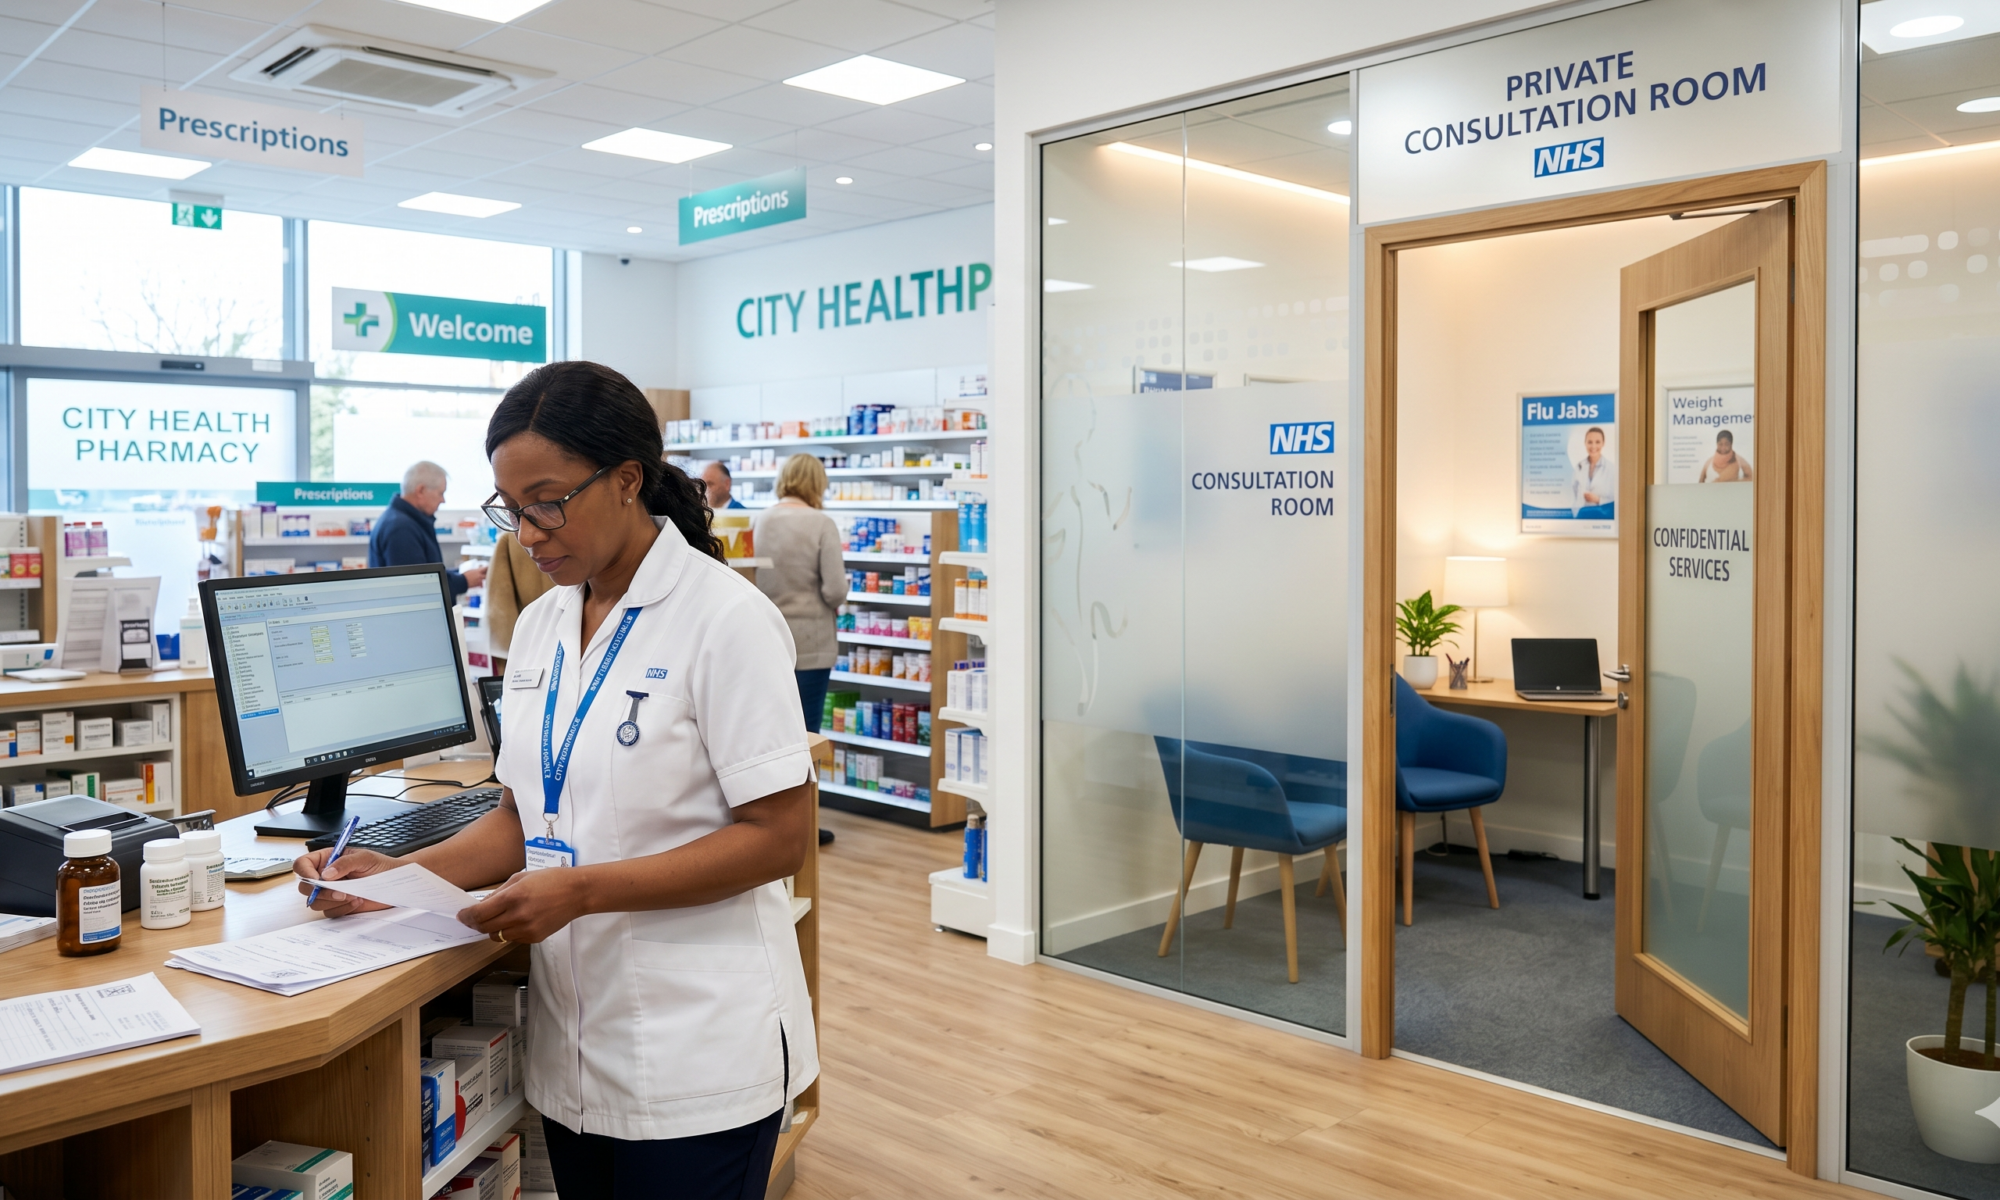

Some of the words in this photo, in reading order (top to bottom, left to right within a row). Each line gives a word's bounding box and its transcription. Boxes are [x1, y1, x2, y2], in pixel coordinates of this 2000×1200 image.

[1507, 51, 1634, 101] PRIVATE
[1404, 88, 1636, 154] CONSULTATION
[1650, 63, 1767, 111] ROOM
[159, 107, 349, 157] Prescriptions
[1536, 139, 1602, 177] NHS
[693, 189, 788, 228] Prescriptions
[736, 290, 806, 339] CITY
[409, 312, 533, 345] Welcome
[1527, 402, 1554, 421] Flu
[1557, 400, 1599, 420] Jabs
[1672, 396, 1723, 412] Weight
[62, 407, 136, 430] CITY
[150, 410, 270, 433] HEALTH
[1672, 413, 1754, 428] Manageme
[1271, 423, 1332, 453] NHS
[77, 439, 260, 464] PHARMACY
[1191, 470, 1334, 491] CONSULTATION
[293, 487, 374, 503] Prescriptions
[1271, 497, 1334, 517] ROOM
[1653, 527, 1750, 552] CONFIDENTIAL
[1669, 556, 1730, 582] SERVICES
[645, 668, 668, 679] NHS
